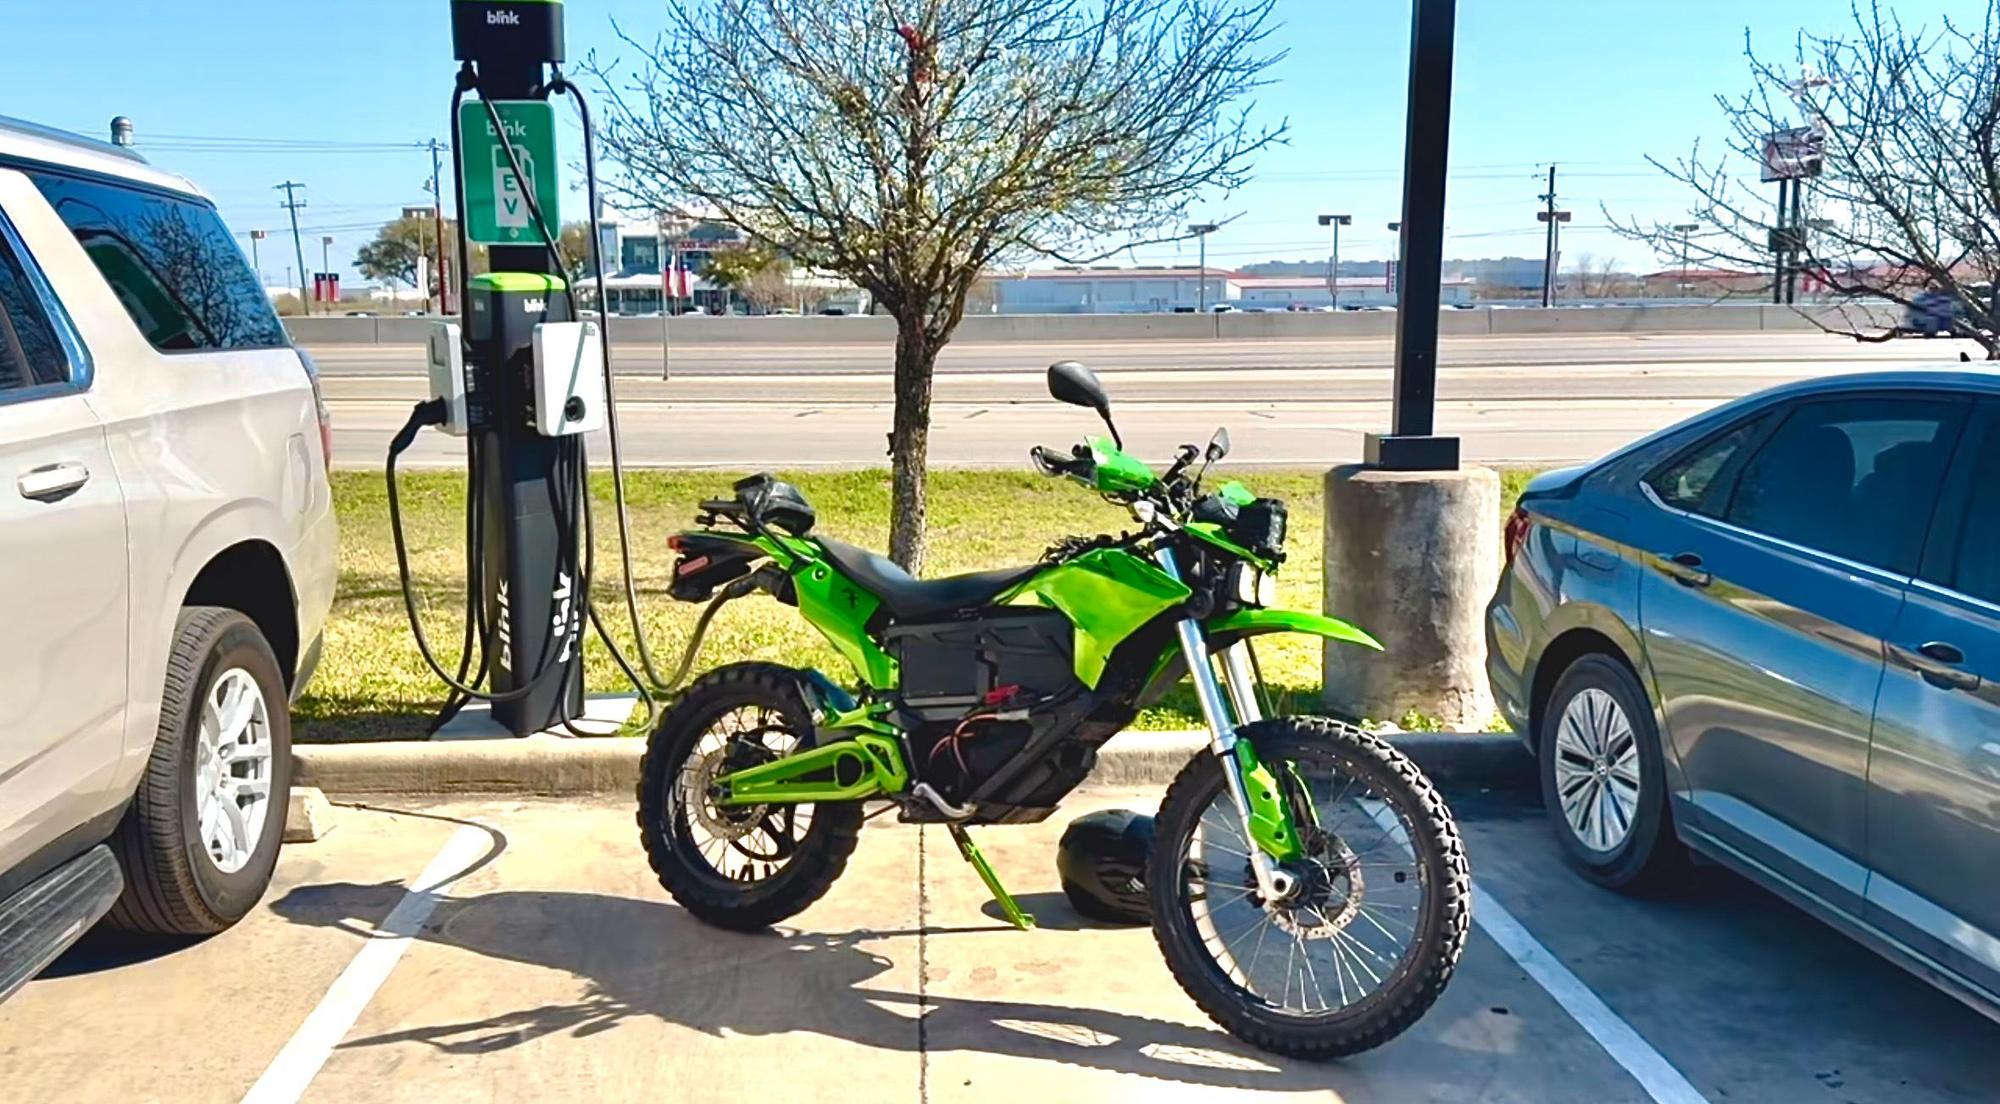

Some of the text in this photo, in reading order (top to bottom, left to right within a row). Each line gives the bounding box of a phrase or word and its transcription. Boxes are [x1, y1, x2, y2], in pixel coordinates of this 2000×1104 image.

[487, 10, 520, 24] blink
[486, 119, 527, 137] bink
[497, 579, 512, 672] blink
